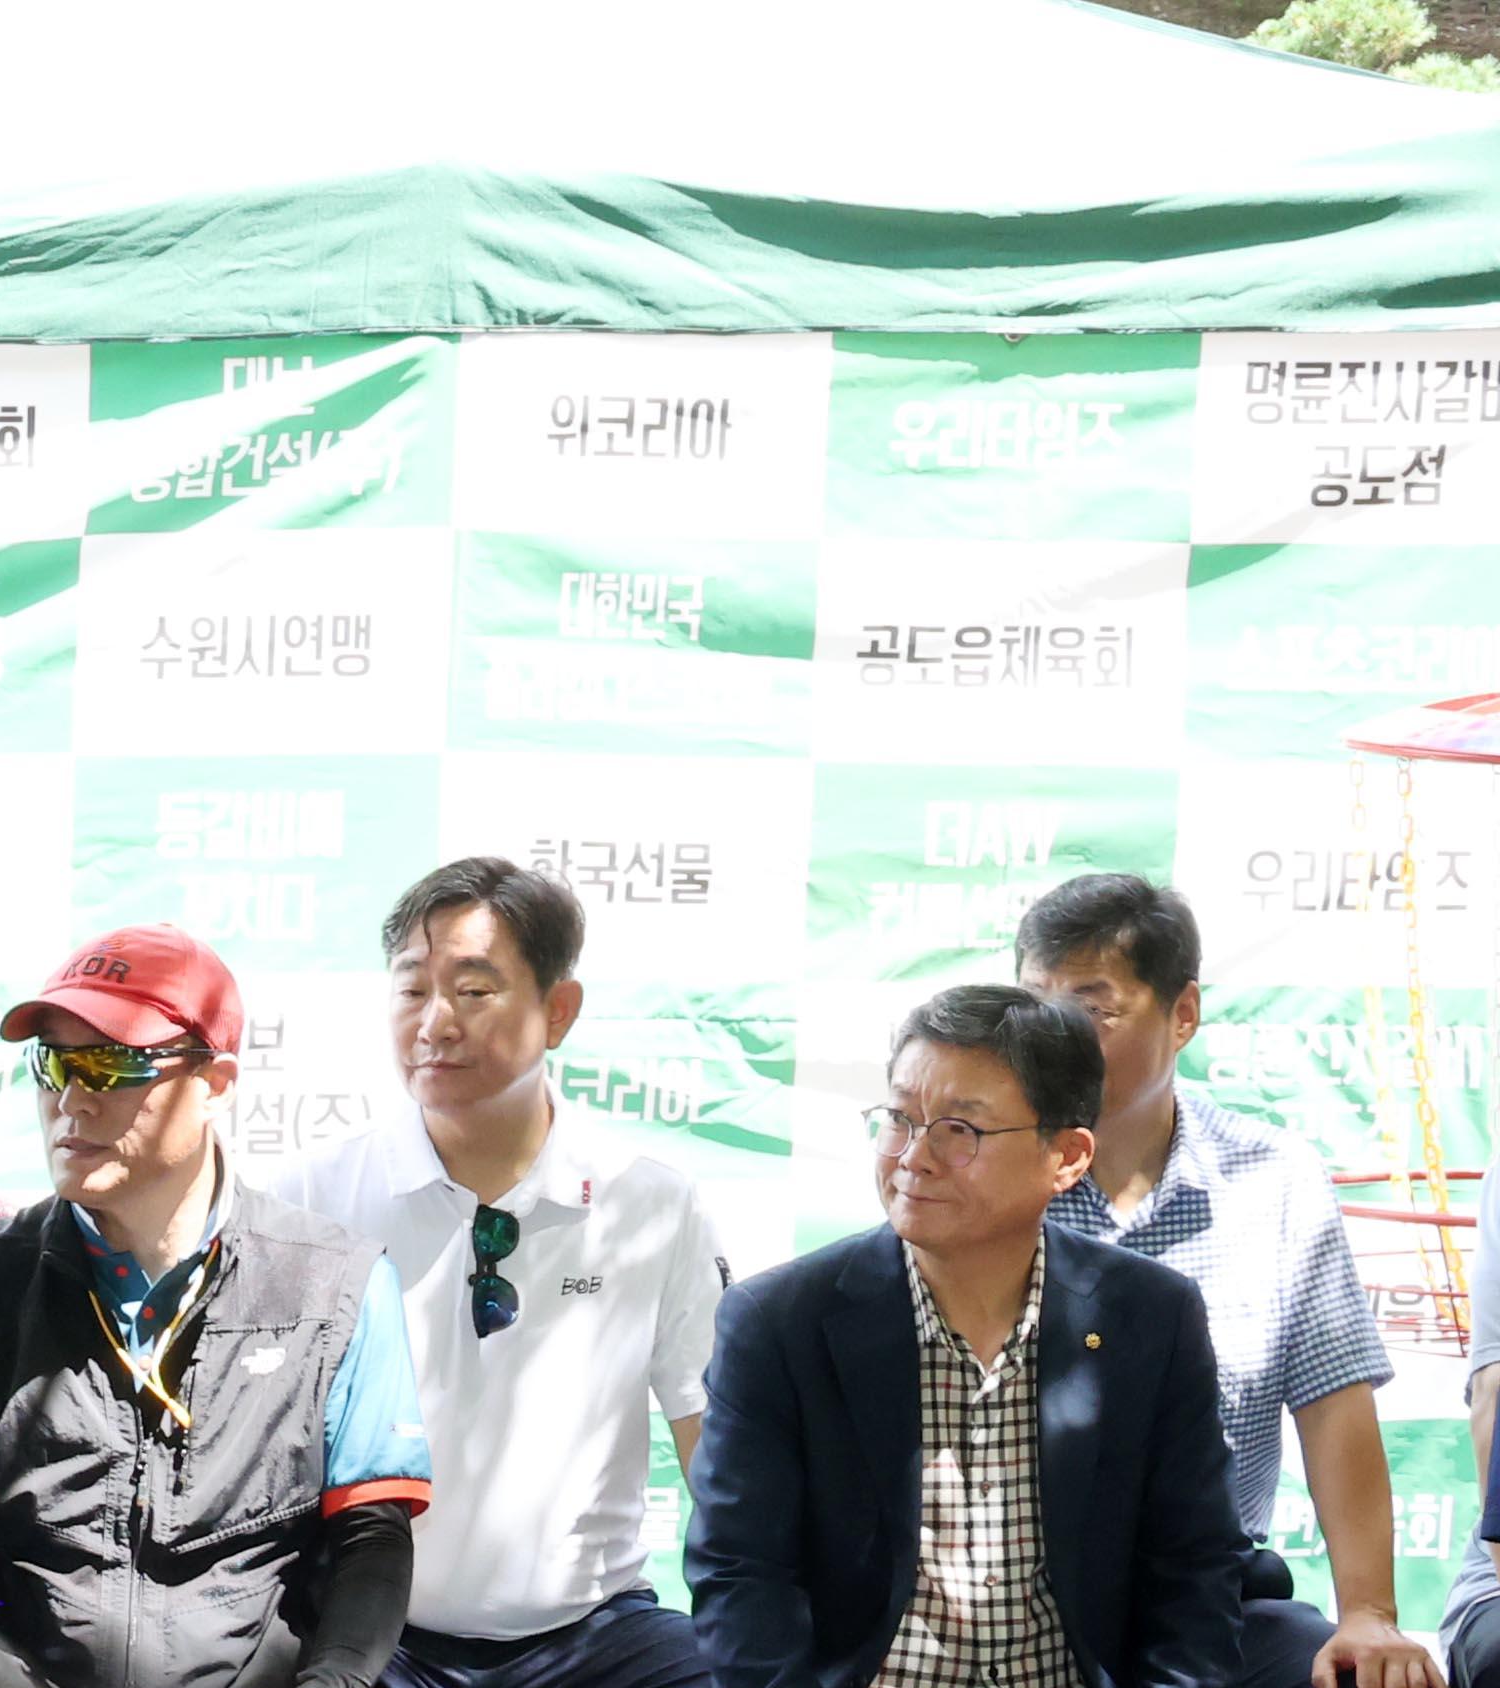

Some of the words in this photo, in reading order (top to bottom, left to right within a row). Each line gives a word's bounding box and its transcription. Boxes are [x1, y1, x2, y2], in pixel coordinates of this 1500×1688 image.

[546, 393, 733, 461] 위코리아
[1309, 444, 1448, 508] 공도점
[559, 571, 704, 642] 대한민국
[139, 613, 374, 681] 수원시연맹
[855, 624, 1135, 690] 공도읍체육회
[61, 951, 132, 984] KOR
[552, 1058, 698, 1123] 코리아
